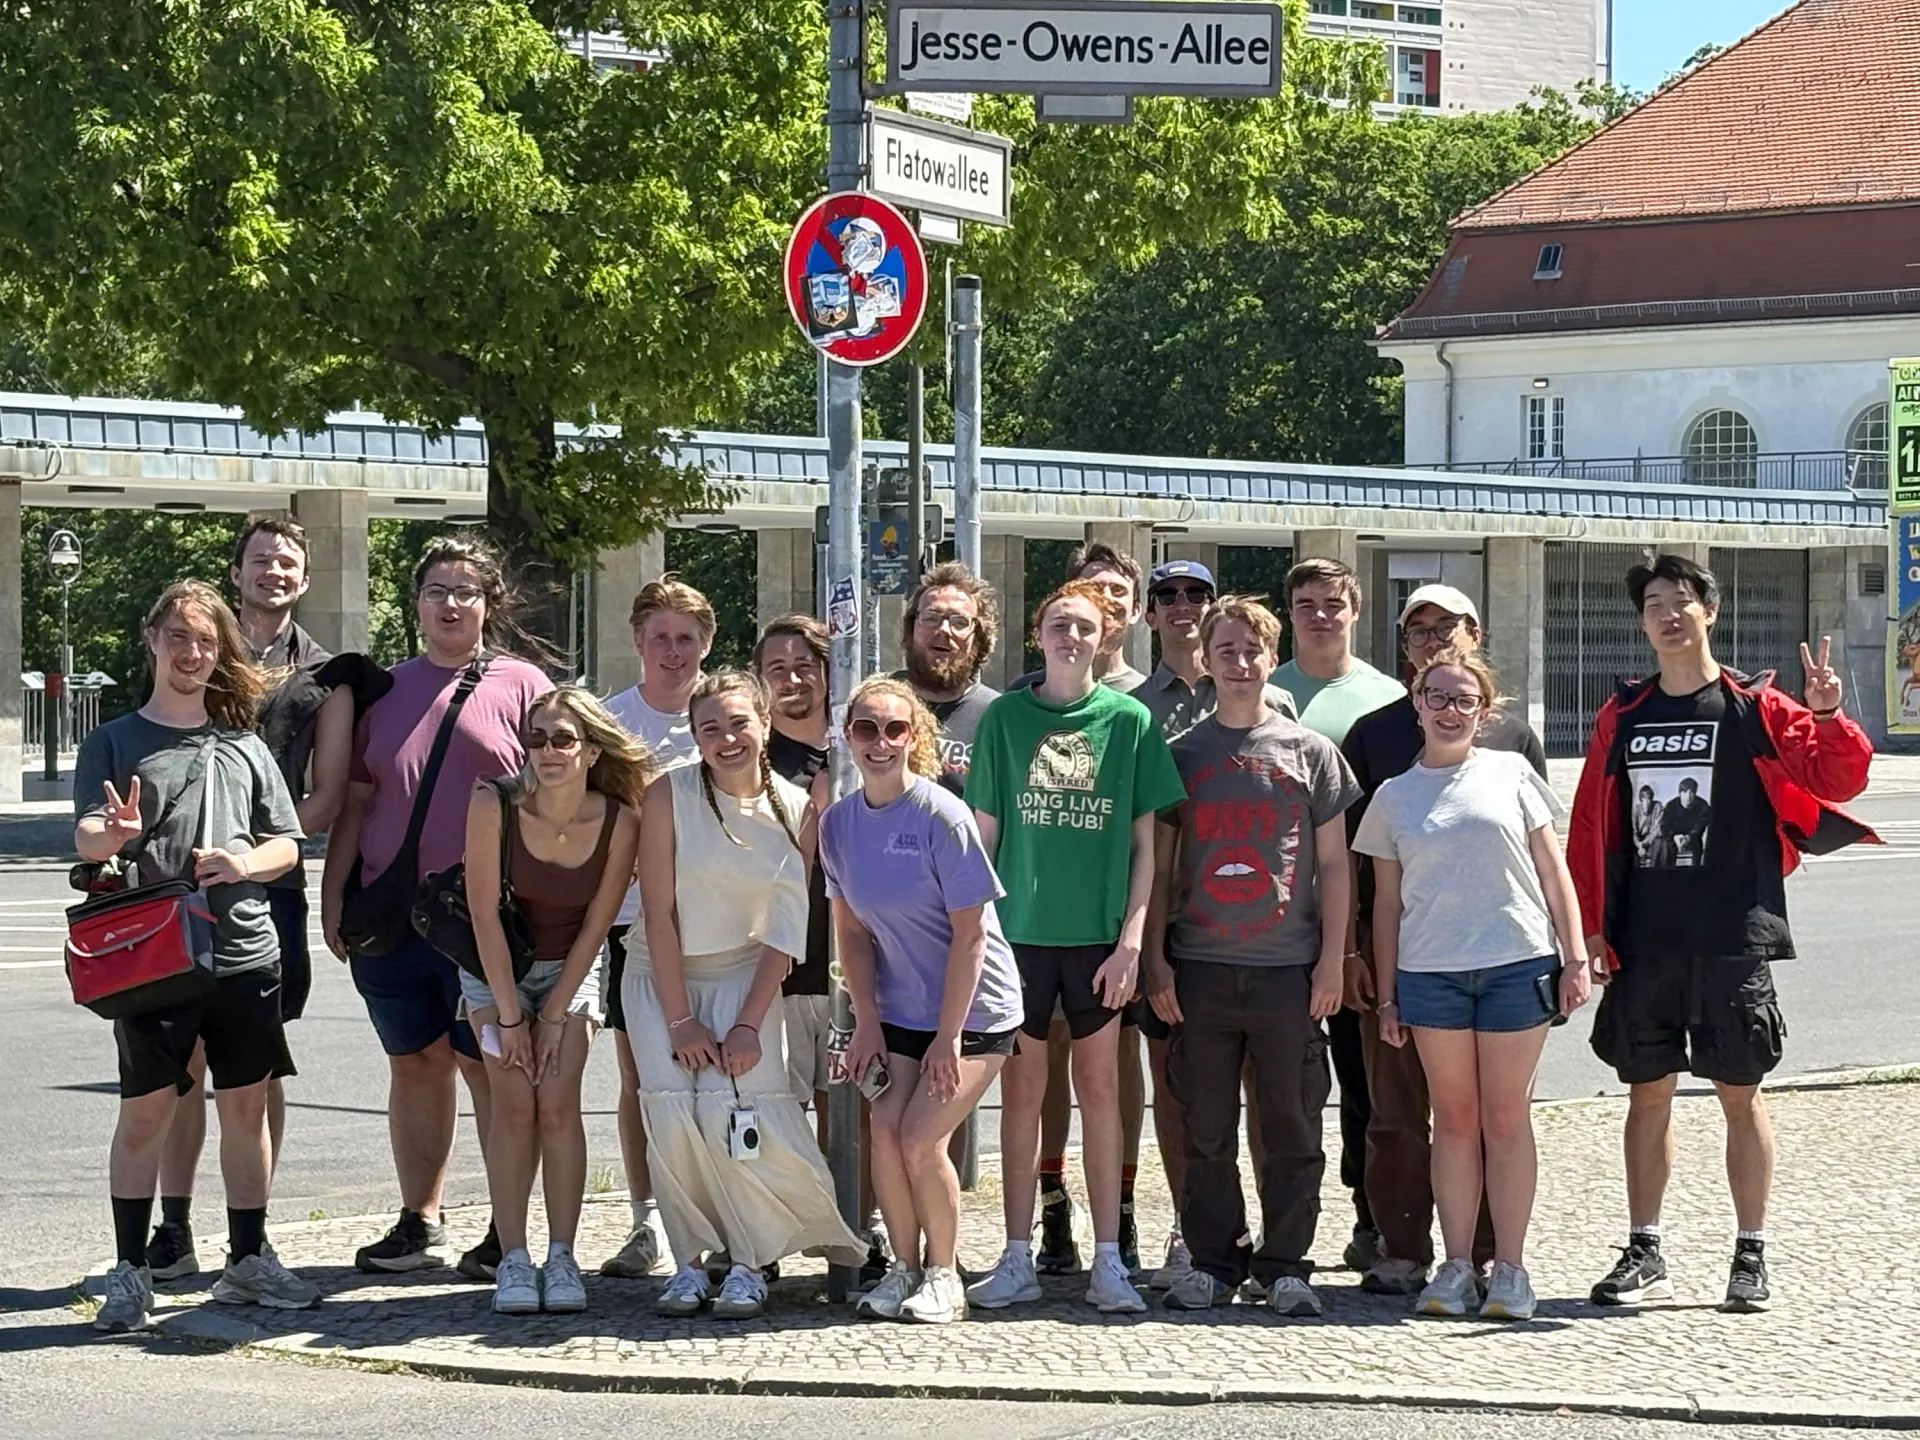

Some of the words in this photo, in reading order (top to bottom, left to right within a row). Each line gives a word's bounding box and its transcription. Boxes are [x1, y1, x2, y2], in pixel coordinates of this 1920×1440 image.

[901, 20, 1270, 72] Jesse-Owens-Allee
[886, 137, 990, 197] Flatowallee
[1629, 729, 1709, 753] oasis
[1067, 778, 1089, 788] RED
[1016, 791, 1064, 809] LONG
[1069, 794, 1114, 815] LIVE
[1021, 809, 1053, 826] THE
[1057, 811, 1104, 831] PUB!
[1194, 799, 1279, 843] KISS
